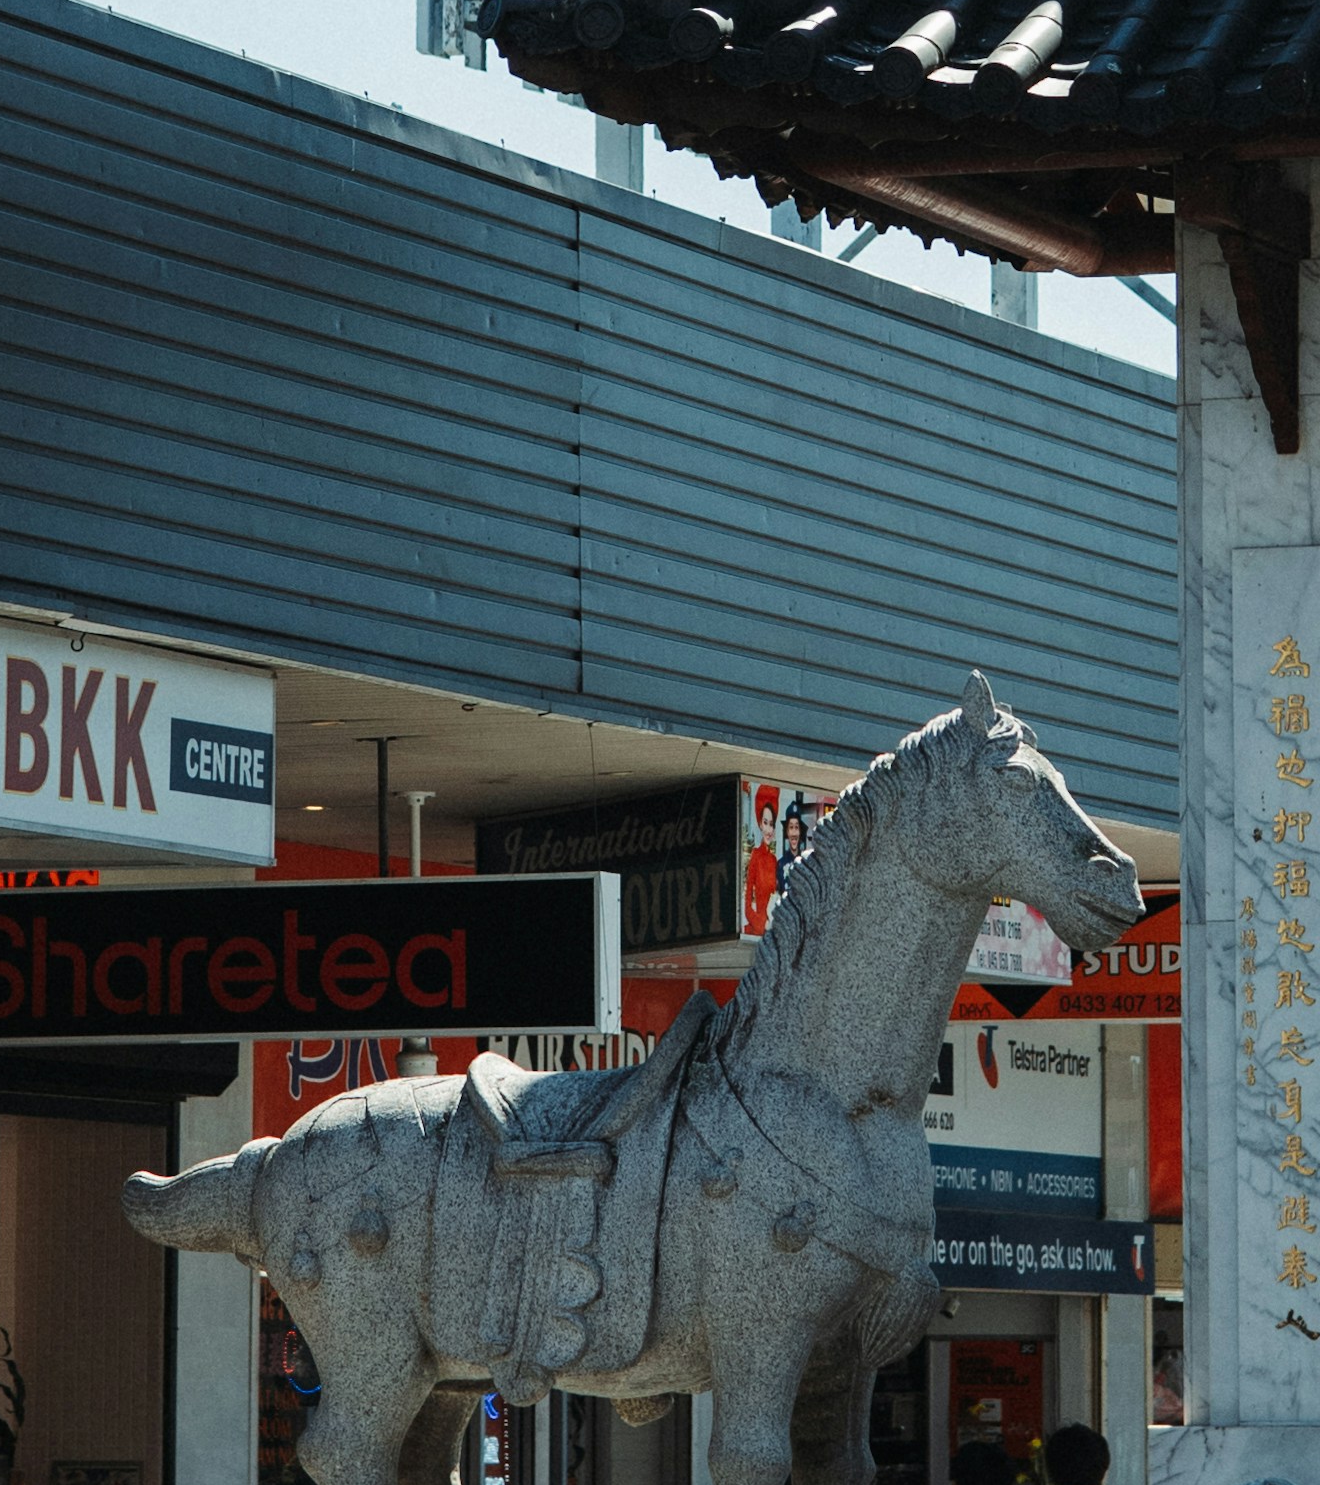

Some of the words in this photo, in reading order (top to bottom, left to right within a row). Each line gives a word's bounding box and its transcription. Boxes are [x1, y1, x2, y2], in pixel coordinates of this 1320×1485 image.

[2, 654, 159, 816] BKK
[184, 736, 266, 789] CENTRE
[504, 790, 713, 873] International
[959, 1002, 993, 1017] DAYS
[1060, 996, 1106, 1013] 0433
[1112, 995, 1145, 1013] 407
[488, 1034, 564, 1072] HAIR
[1008, 1039, 1046, 1072] Telstra
[1048, 1044, 1090, 1078] Partner
[991, 1169, 1013, 1193] NBN
[1026, 1172, 1096, 1199] ACCESSORIES
[950, 1241, 966, 1264] or
[969, 1243, 987, 1265] on
[990, 1235, 1013, 1265] the
[1016, 1245, 1038, 1273] go,
[1040, 1238, 1065, 1268] ask
[1067, 1248, 1082, 1269] us
[1085, 1240, 1116, 1272] how.
